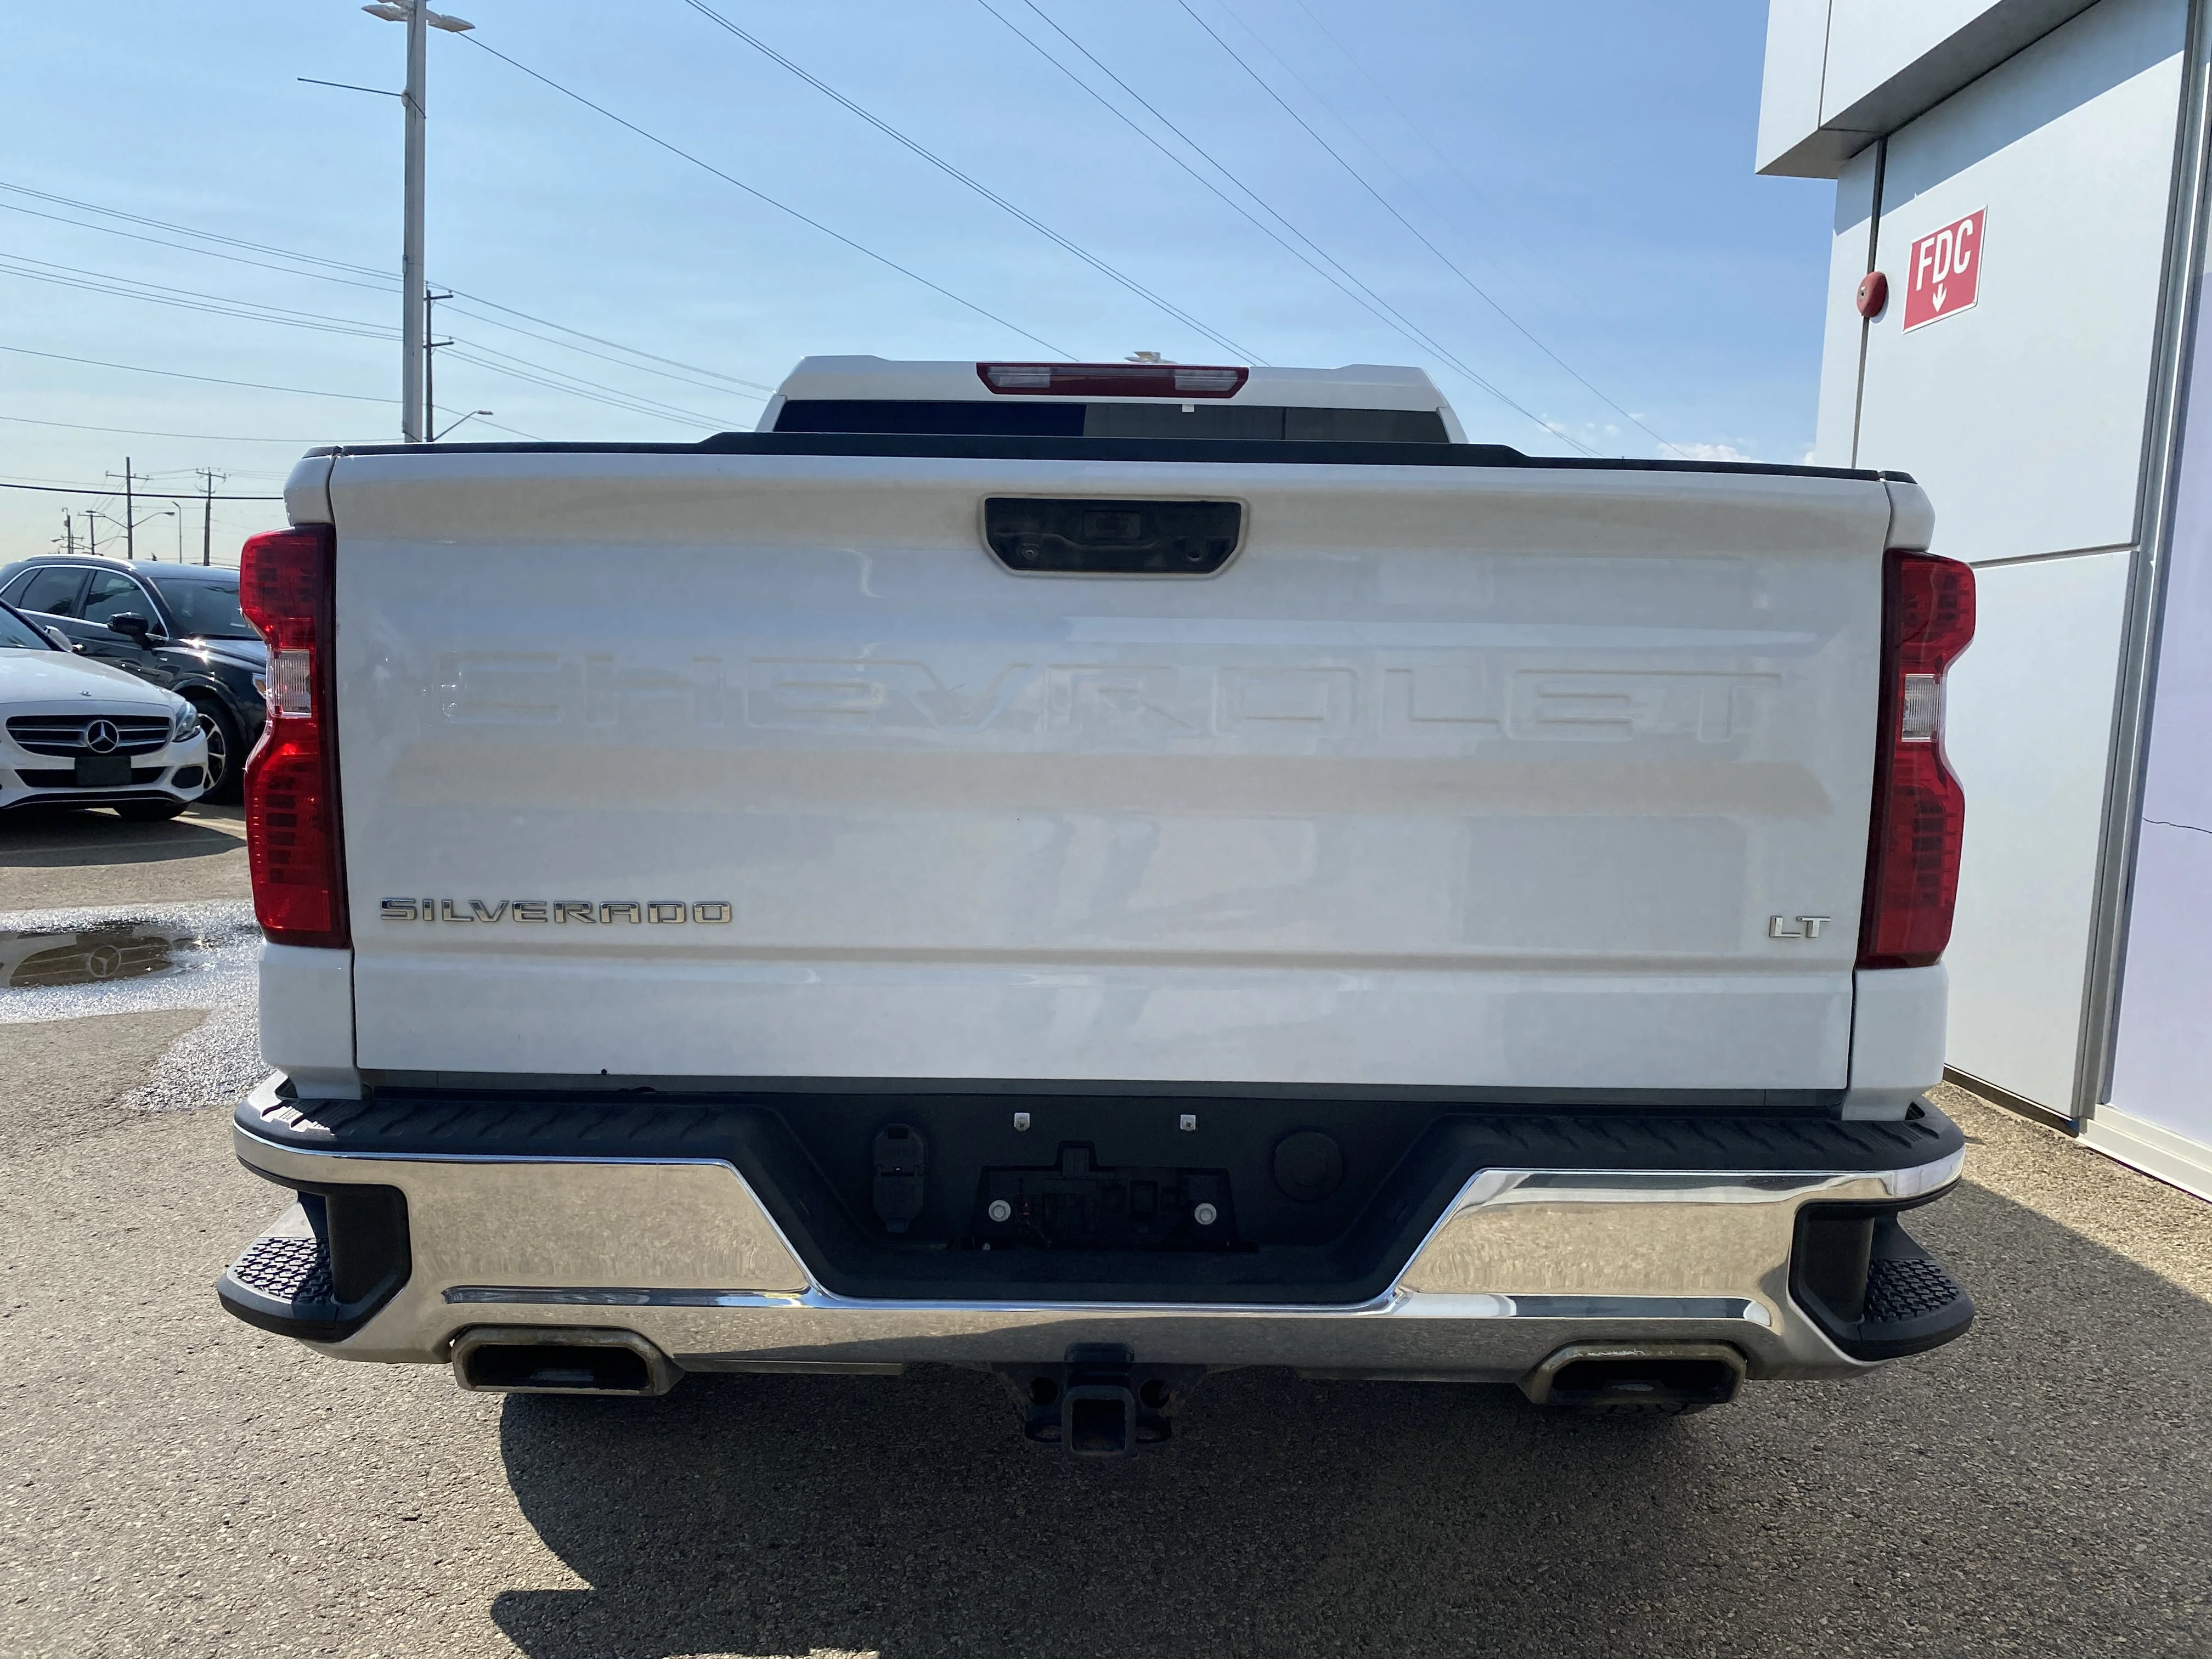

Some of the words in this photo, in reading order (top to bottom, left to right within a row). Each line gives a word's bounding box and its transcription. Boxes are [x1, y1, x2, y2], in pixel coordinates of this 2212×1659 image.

[1916, 219, 1973, 291] FDC
[439, 651, 1781, 743] CHEVROLET
[380, 898, 732, 924] SILVERADO
[1769, 915, 1831, 938] LT
